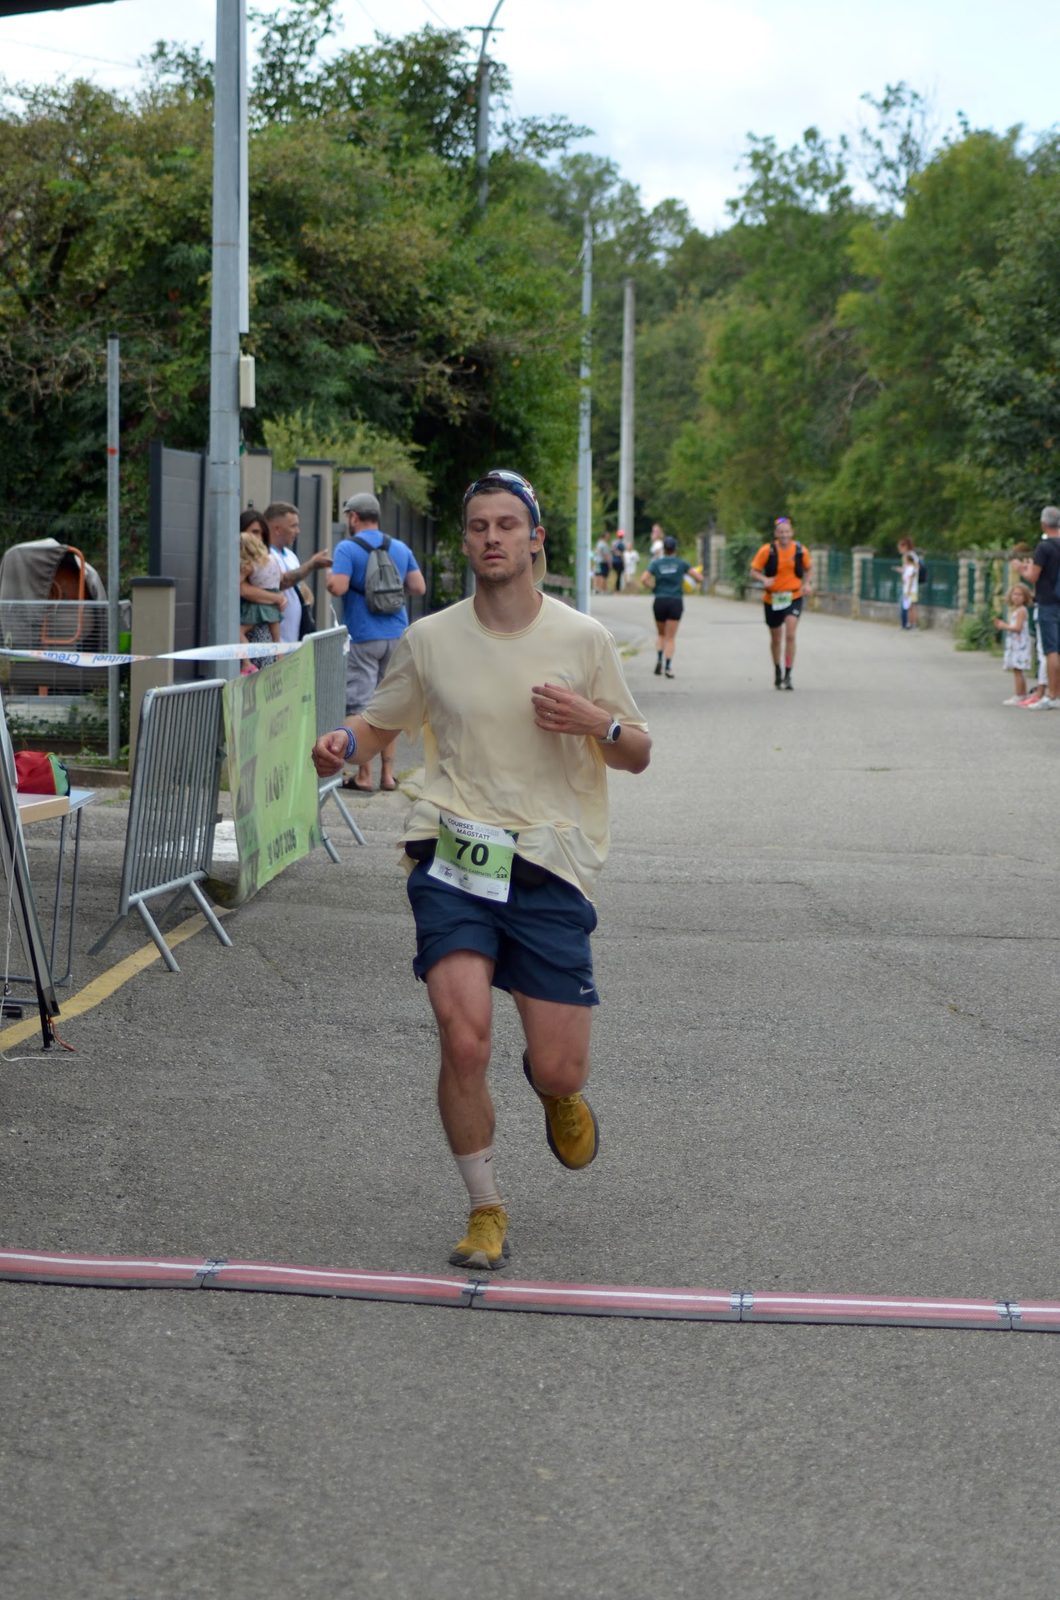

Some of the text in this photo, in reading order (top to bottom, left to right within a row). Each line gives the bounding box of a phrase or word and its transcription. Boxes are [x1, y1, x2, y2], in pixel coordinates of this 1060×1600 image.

[447, 817, 474, 830] COURSES
[456, 828, 490, 840] MAGSTATT
[455, 837, 489, 867] 70
